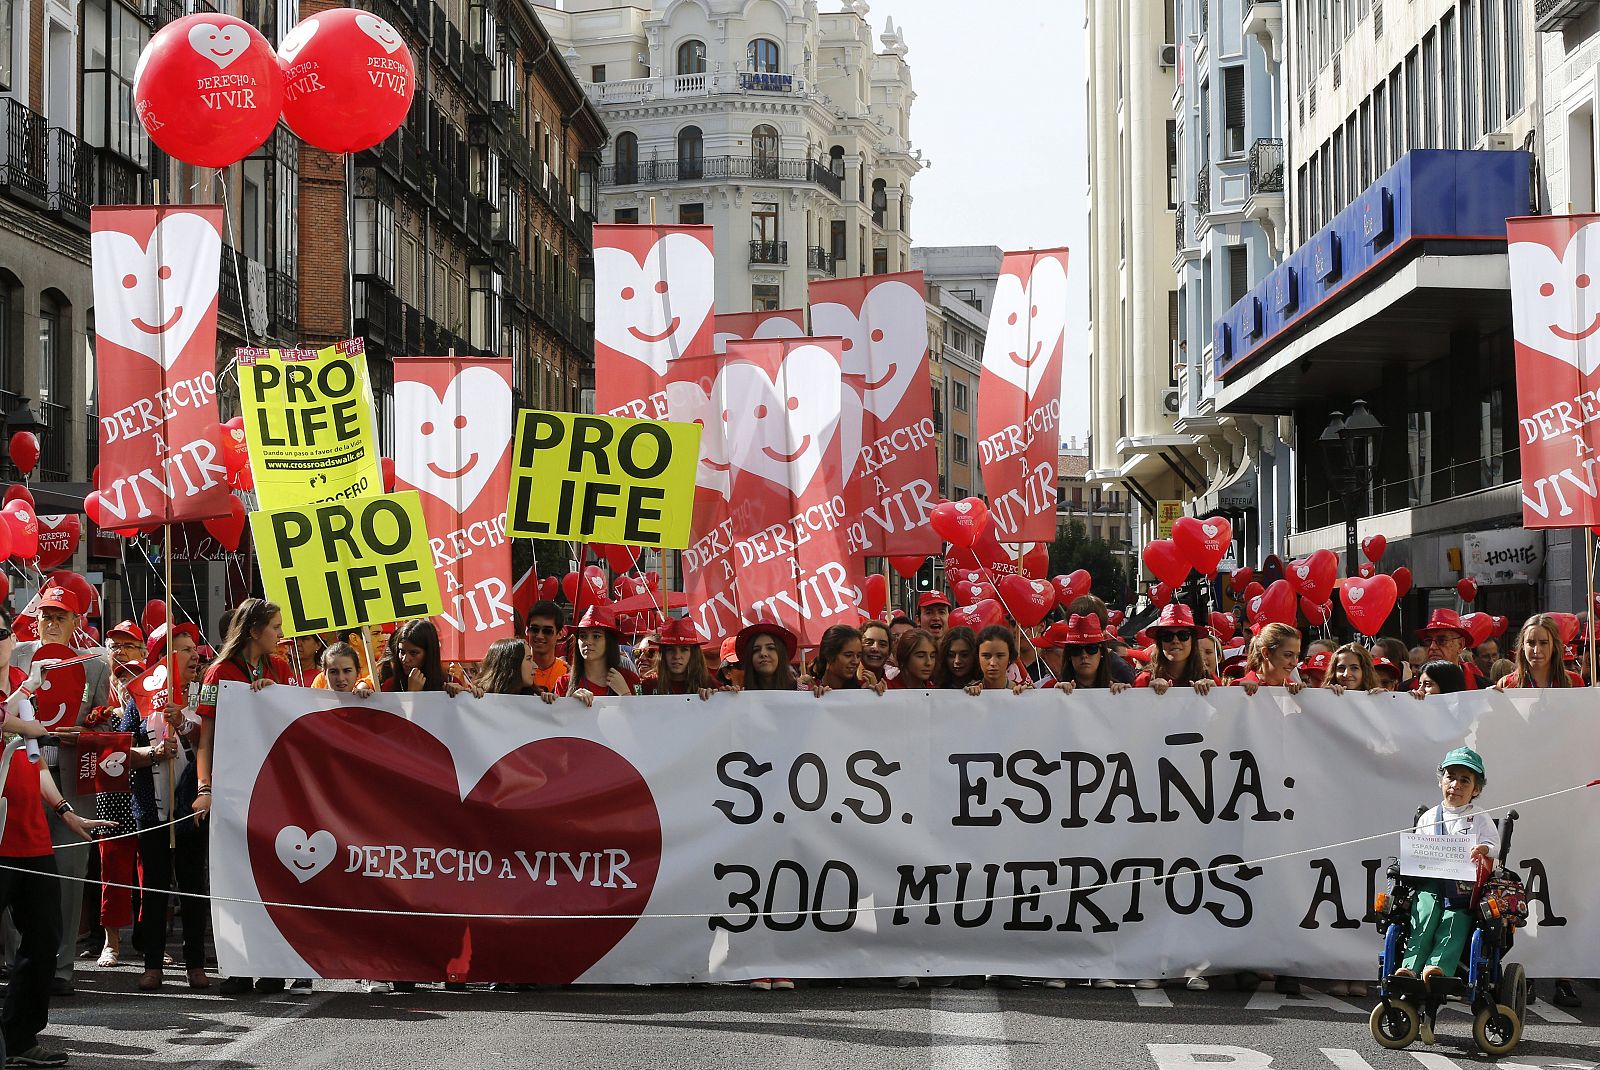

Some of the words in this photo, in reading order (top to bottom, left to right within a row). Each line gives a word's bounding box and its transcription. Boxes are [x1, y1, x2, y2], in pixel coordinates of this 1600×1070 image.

[368, 57, 405, 73] DERECHO
[198, 74, 249, 90] DERECHO
[251, 78, 257, 86] A
[368, 70, 407, 97] VIVIR
[200, 88, 257, 110] VIVIR
[301, 349, 317, 357] LIFE
[345, 338, 362, 348] PRO
[345, 345, 361, 355] LIFE
[239, 356, 256, 364] LIFE
[280, 351, 296, 359] LIFE
[253, 359, 355, 403] PRO
[100, 370, 217, 445] DERECHO
[1520, 387, 1600, 444] DERE
[257, 399, 361, 447] LIFE
[978, 398, 1060, 465] DERECHO
[155, 433, 171, 456] A
[315, 447, 333, 455] favor
[519, 412, 673, 479] PRO
[860, 417, 935, 477] RECHO
[1572, 434, 1594, 457] A
[267, 450, 364, 469] www.crossroadswalk.es
[1018, 456, 1030, 478] A
[98, 439, 229, 521] VIVIR
[874, 475, 890, 496] A
[1522, 458, 1598, 518] VIV
[513, 475, 665, 543] LIFE
[988, 461, 1057, 536] VIVIR
[1220, 497, 1253, 505] PELETERIA
[39, 531, 66, 541] DERECHO
[271, 500, 412, 568] PRO
[428, 512, 508, 569] RECHO
[735, 495, 846, 568] DERECHO
[40, 540, 69, 551] VIVIR
[721, 558, 734, 580] A
[787, 556, 806, 579] A
[991, 561, 1028, 575] DERECO
[444, 570, 463, 592] A
[285, 560, 429, 634] LIFE
[441, 577, 514, 632] VIR
[694, 577, 743, 641] VIV
[201, 693, 216, 702] LIFE
[202, 684, 217, 693] PRO
[712, 751, 913, 825] S.O.S.
[950, 732, 1296, 828] ESPAÑA:
[1414, 849, 1444, 857] ABORTO
[345, 844, 493, 882] DERECHO
[499, 858, 516, 880] A
[515, 849, 637, 889] VIVIR
[707, 859, 860, 933] 300
[892, 854, 1264, 934] MUERTOS
